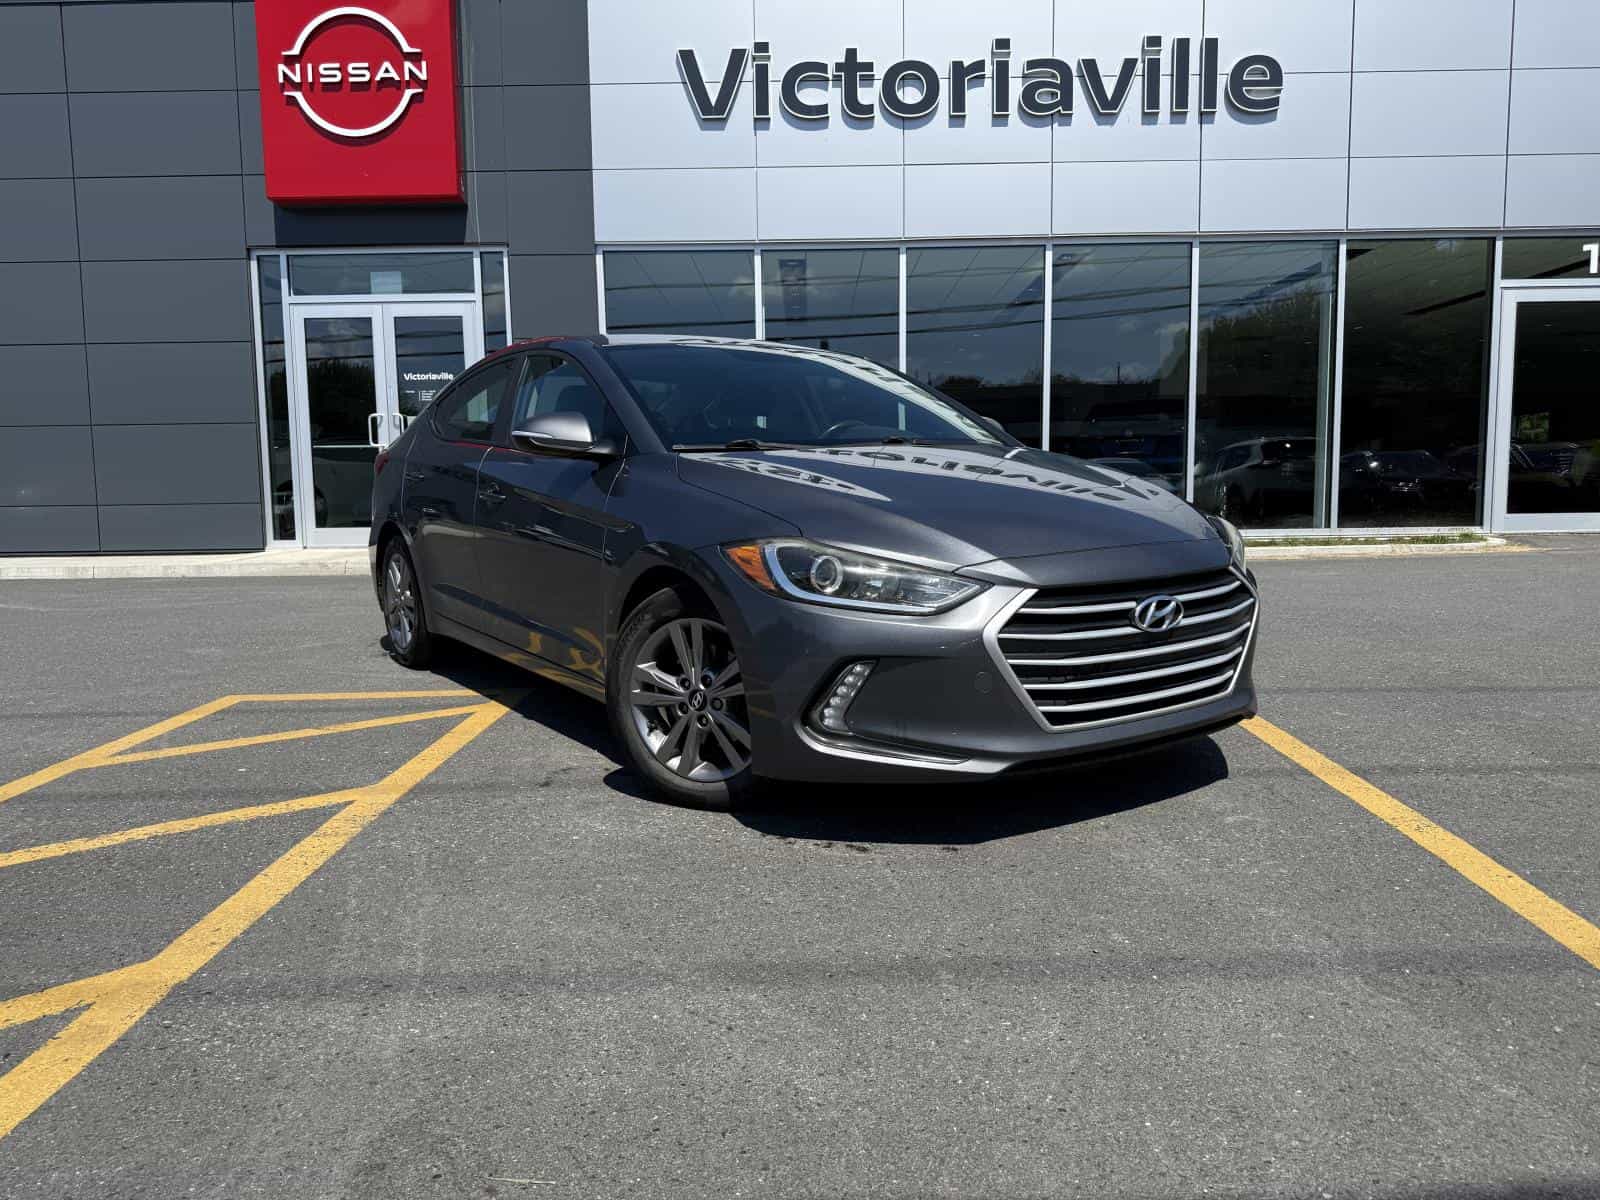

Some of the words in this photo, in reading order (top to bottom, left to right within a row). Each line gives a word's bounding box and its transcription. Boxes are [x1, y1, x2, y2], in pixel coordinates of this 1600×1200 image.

[277, 60, 428, 84] NISSAN
[676, 35, 1284, 120] Victoriaville
[1582, 243, 1599, 274] 1
[403, 372, 454, 381] Victoriaville
